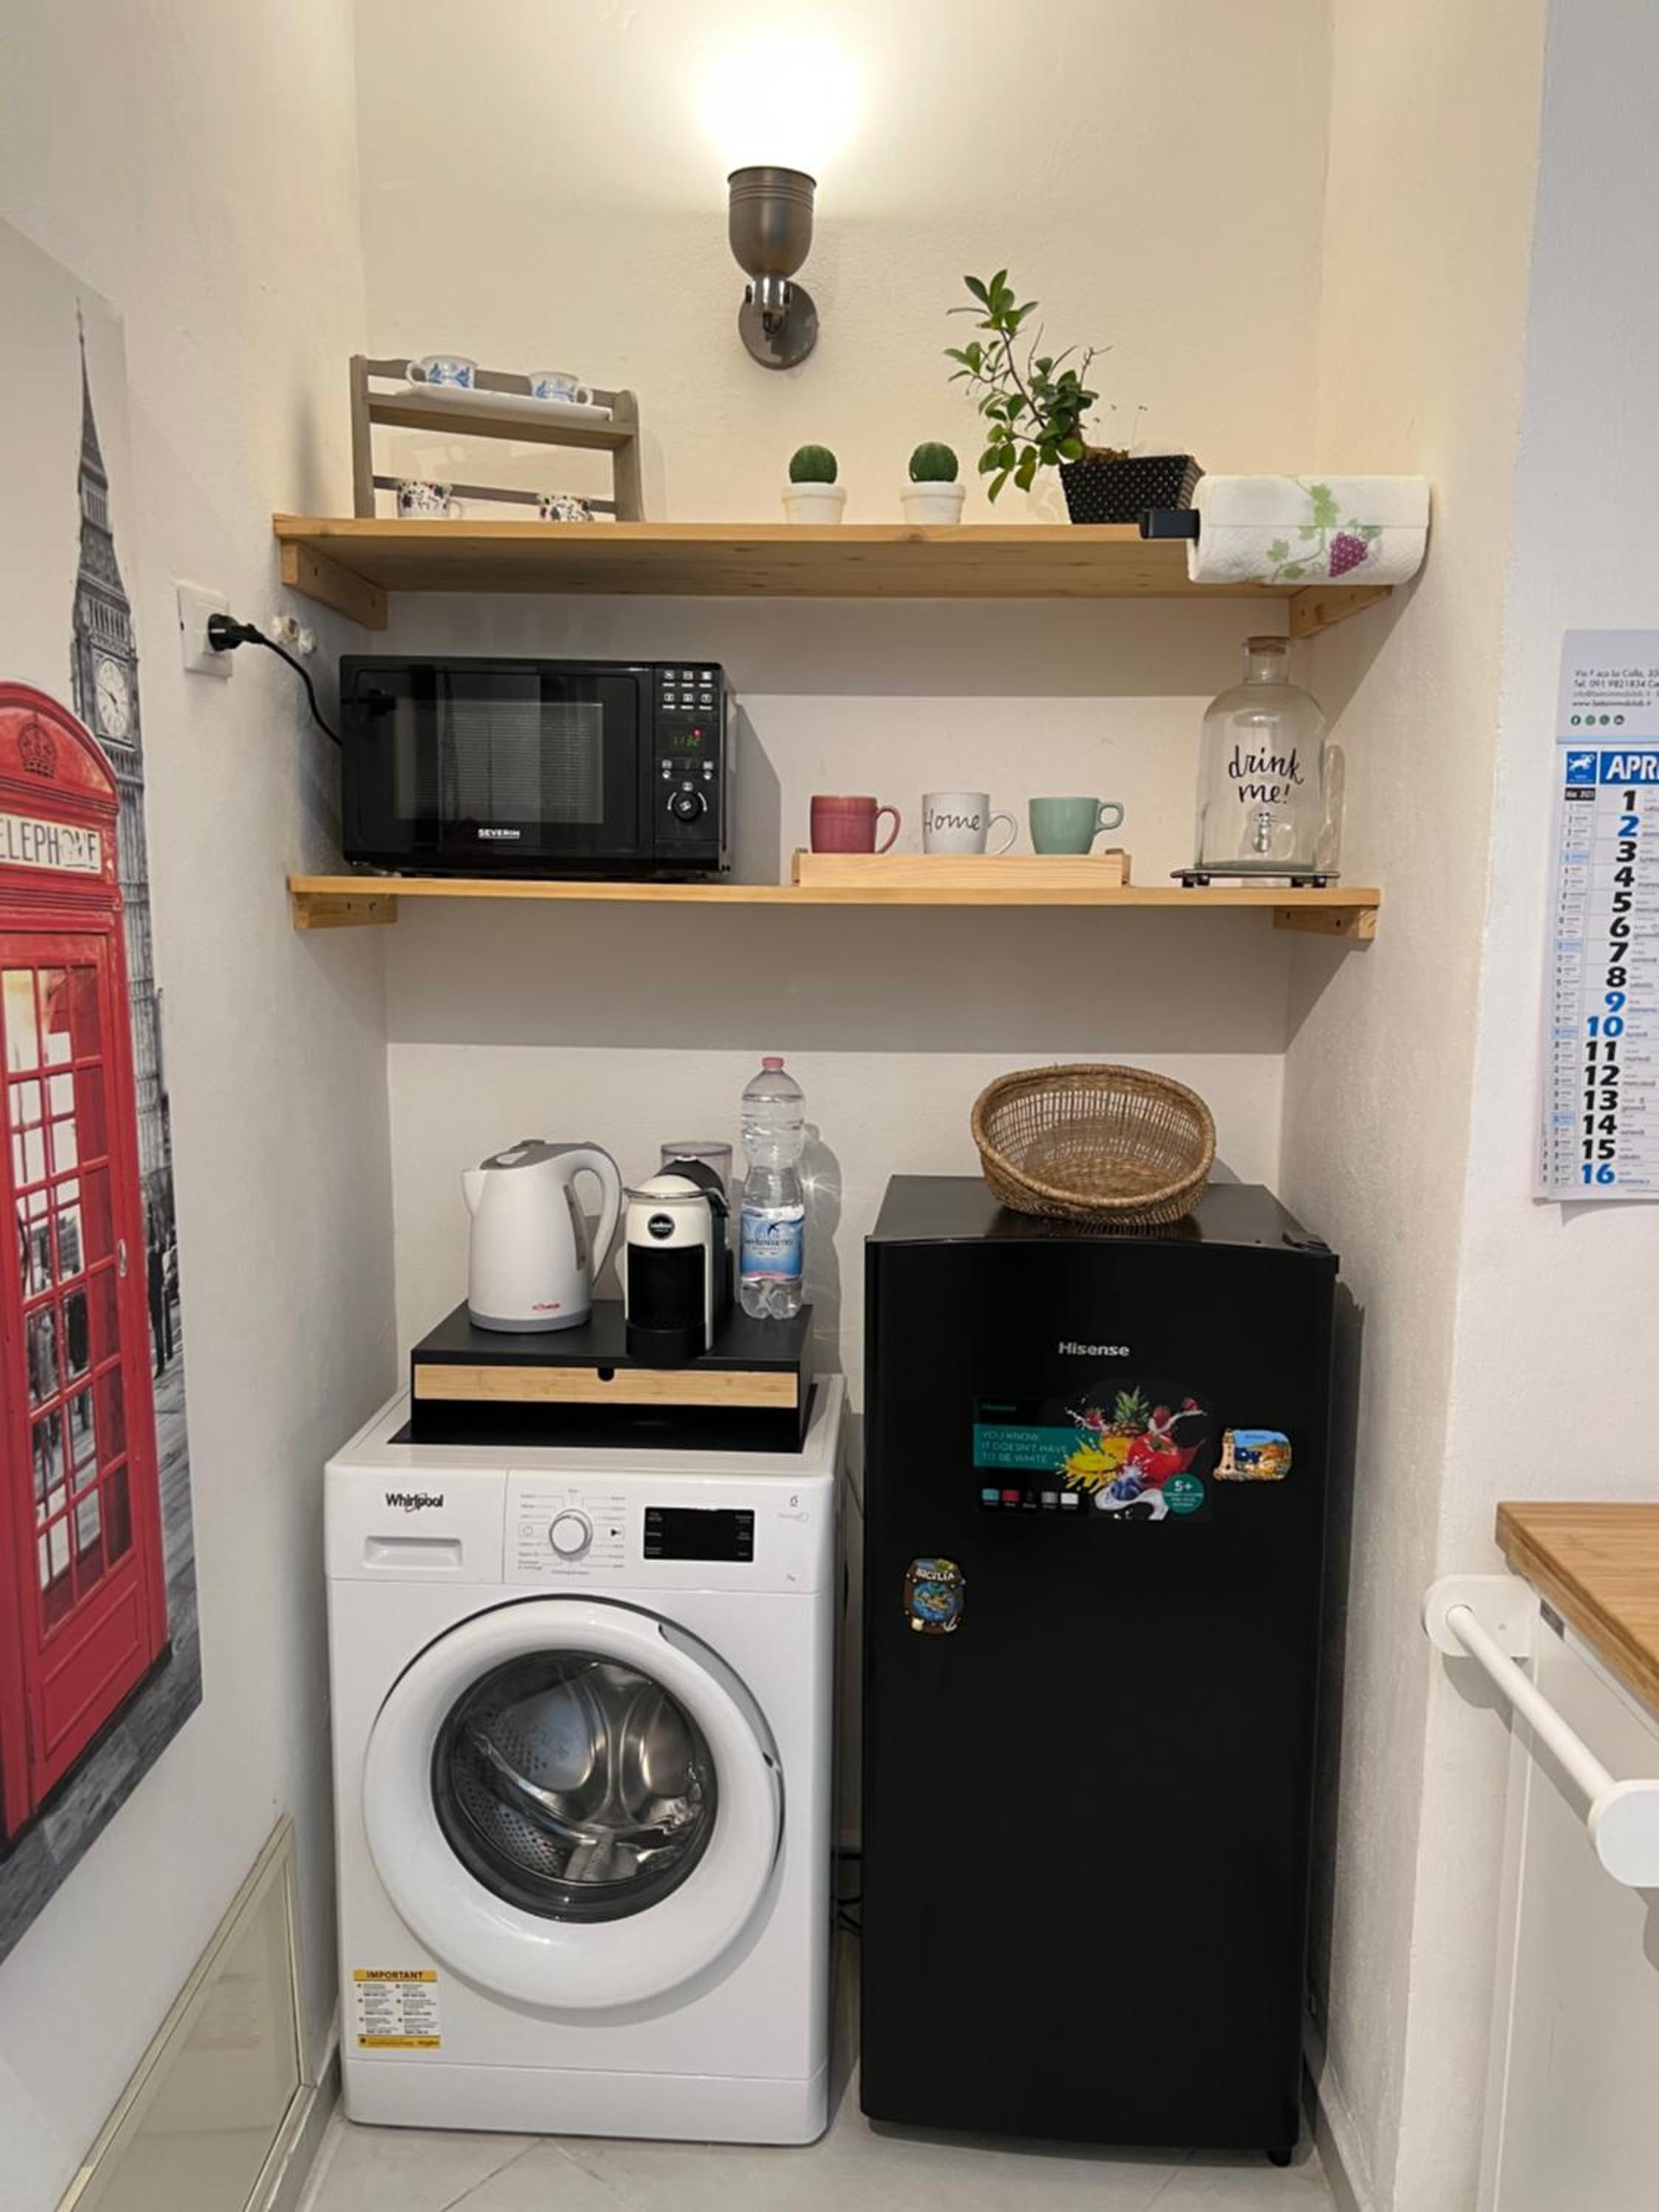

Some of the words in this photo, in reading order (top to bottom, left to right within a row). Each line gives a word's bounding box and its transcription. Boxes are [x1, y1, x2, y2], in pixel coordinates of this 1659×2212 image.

[1228, 743, 1304, 785] drink
[1605, 754, 1659, 780] APR
[1238, 784, 1290, 804] me!
[1624, 790, 1636, 811] 1
[924, 808, 981, 832] Home
[1618, 815, 1639, 838] 2
[478, 829, 520, 839] SEVERIN
[1615, 841, 1637, 863] 3
[1614, 866, 1635, 888] 4
[1612, 891, 1632, 913] 5
[1610, 917, 1630, 938] 6
[1610, 942, 1629, 963] 7
[1606, 966, 1627, 988] 8
[1604, 991, 1626, 1012] 9
[1587, 1015, 1624, 1037] 10
[1586, 1040, 1617, 1062] 11
[1585, 1065, 1620, 1086] 12
[1584, 1090, 1618, 1110] 13
[1583, 1114, 1617, 1135] 14
[1582, 1139, 1615, 1160] 15
[1582, 1163, 1615, 1185] 16
[1058, 1341, 1130, 1357] Hisense
[982, 1452, 996, 1461] TO
[385, 1492, 444, 1512] Whirlpool
[366, 1970, 423, 1979] IMPORTANT
